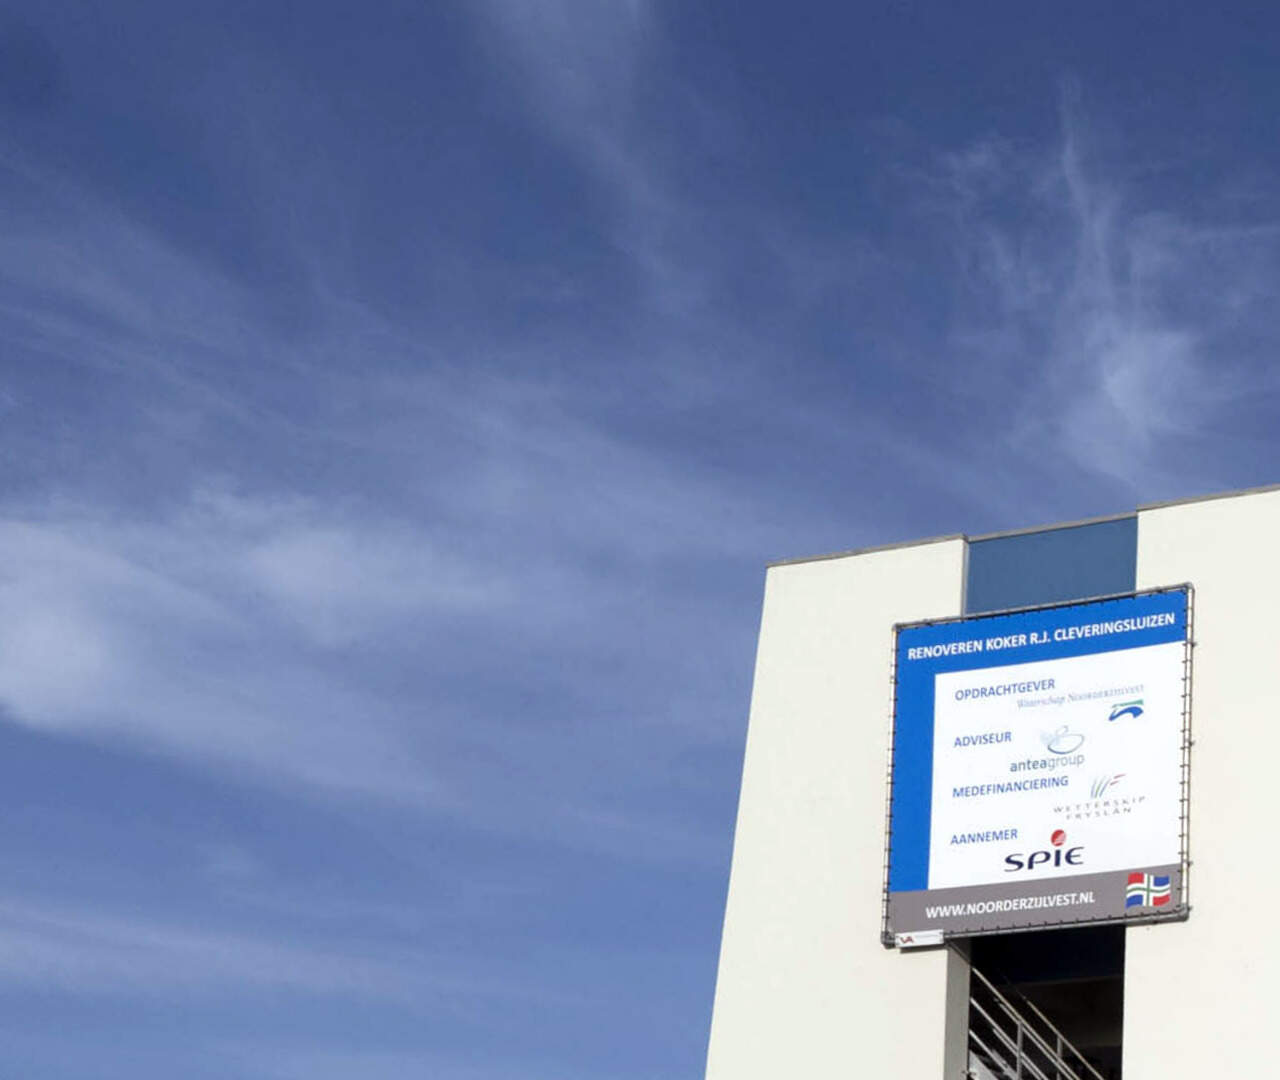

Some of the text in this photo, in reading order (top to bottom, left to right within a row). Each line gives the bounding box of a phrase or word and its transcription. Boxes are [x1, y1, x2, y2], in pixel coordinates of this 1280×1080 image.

[908, 612, 1176, 660] RENOVEREN KOKER R.J. CLEVERINGSLUIZEN
[955, 678, 1055, 701] OPDRACHTGEVER
[954, 731, 1012, 748] ADVISEUR
[952, 775, 1069, 798] MEDEFINANCIERING
[950, 829, 1018, 845] AANNEMER
[1004, 846, 1085, 872] SPIE
[925, 891, 1096, 919] WWW.NOORDERZIJLVEST.NL
